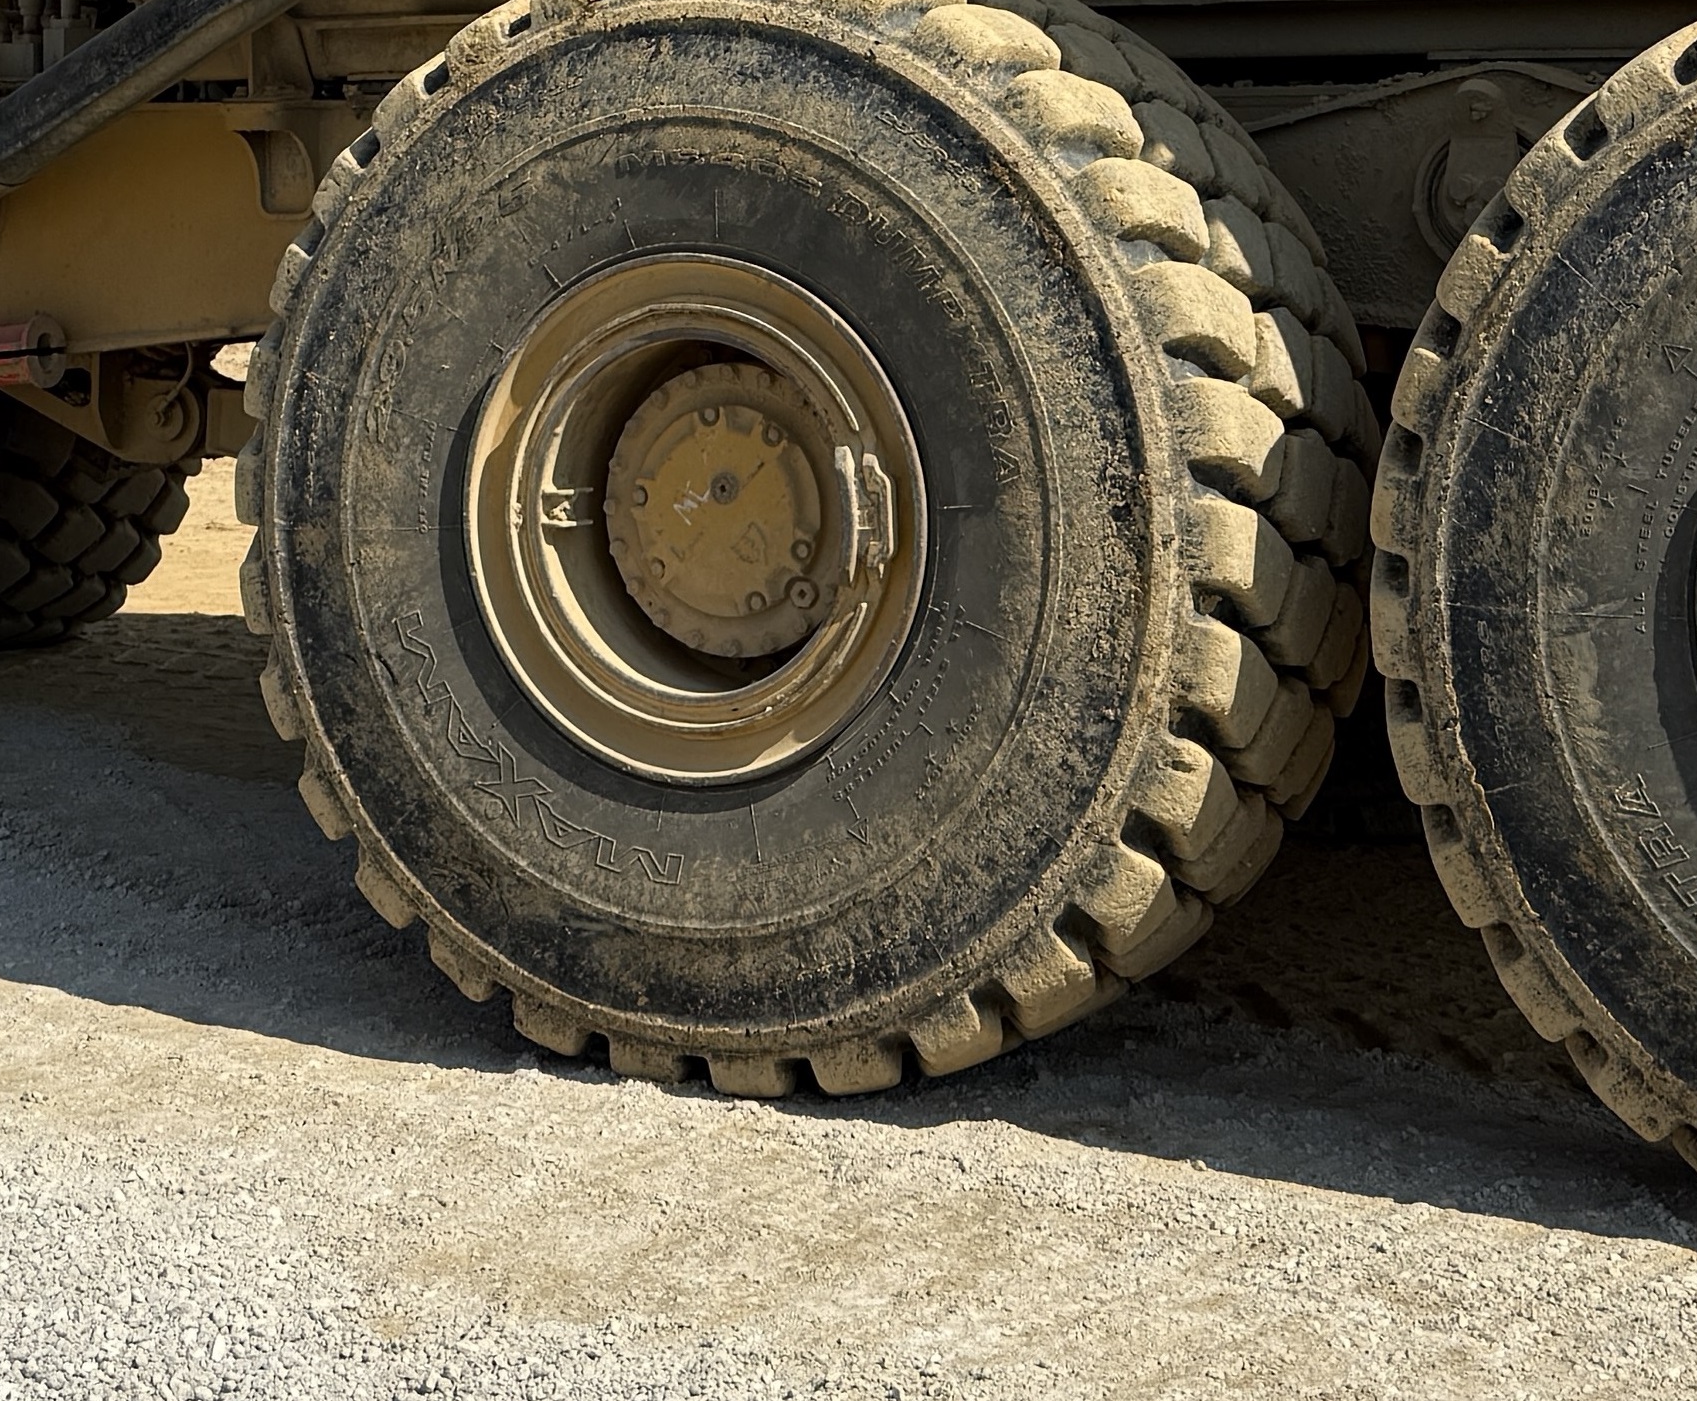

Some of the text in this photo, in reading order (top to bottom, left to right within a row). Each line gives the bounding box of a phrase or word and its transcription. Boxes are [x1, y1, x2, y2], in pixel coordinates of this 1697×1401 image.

[1634, 498, 1659, 572] STEEL
[1633, 591, 1648, 635] ALL
[392, 610, 685, 885] MAXAM
